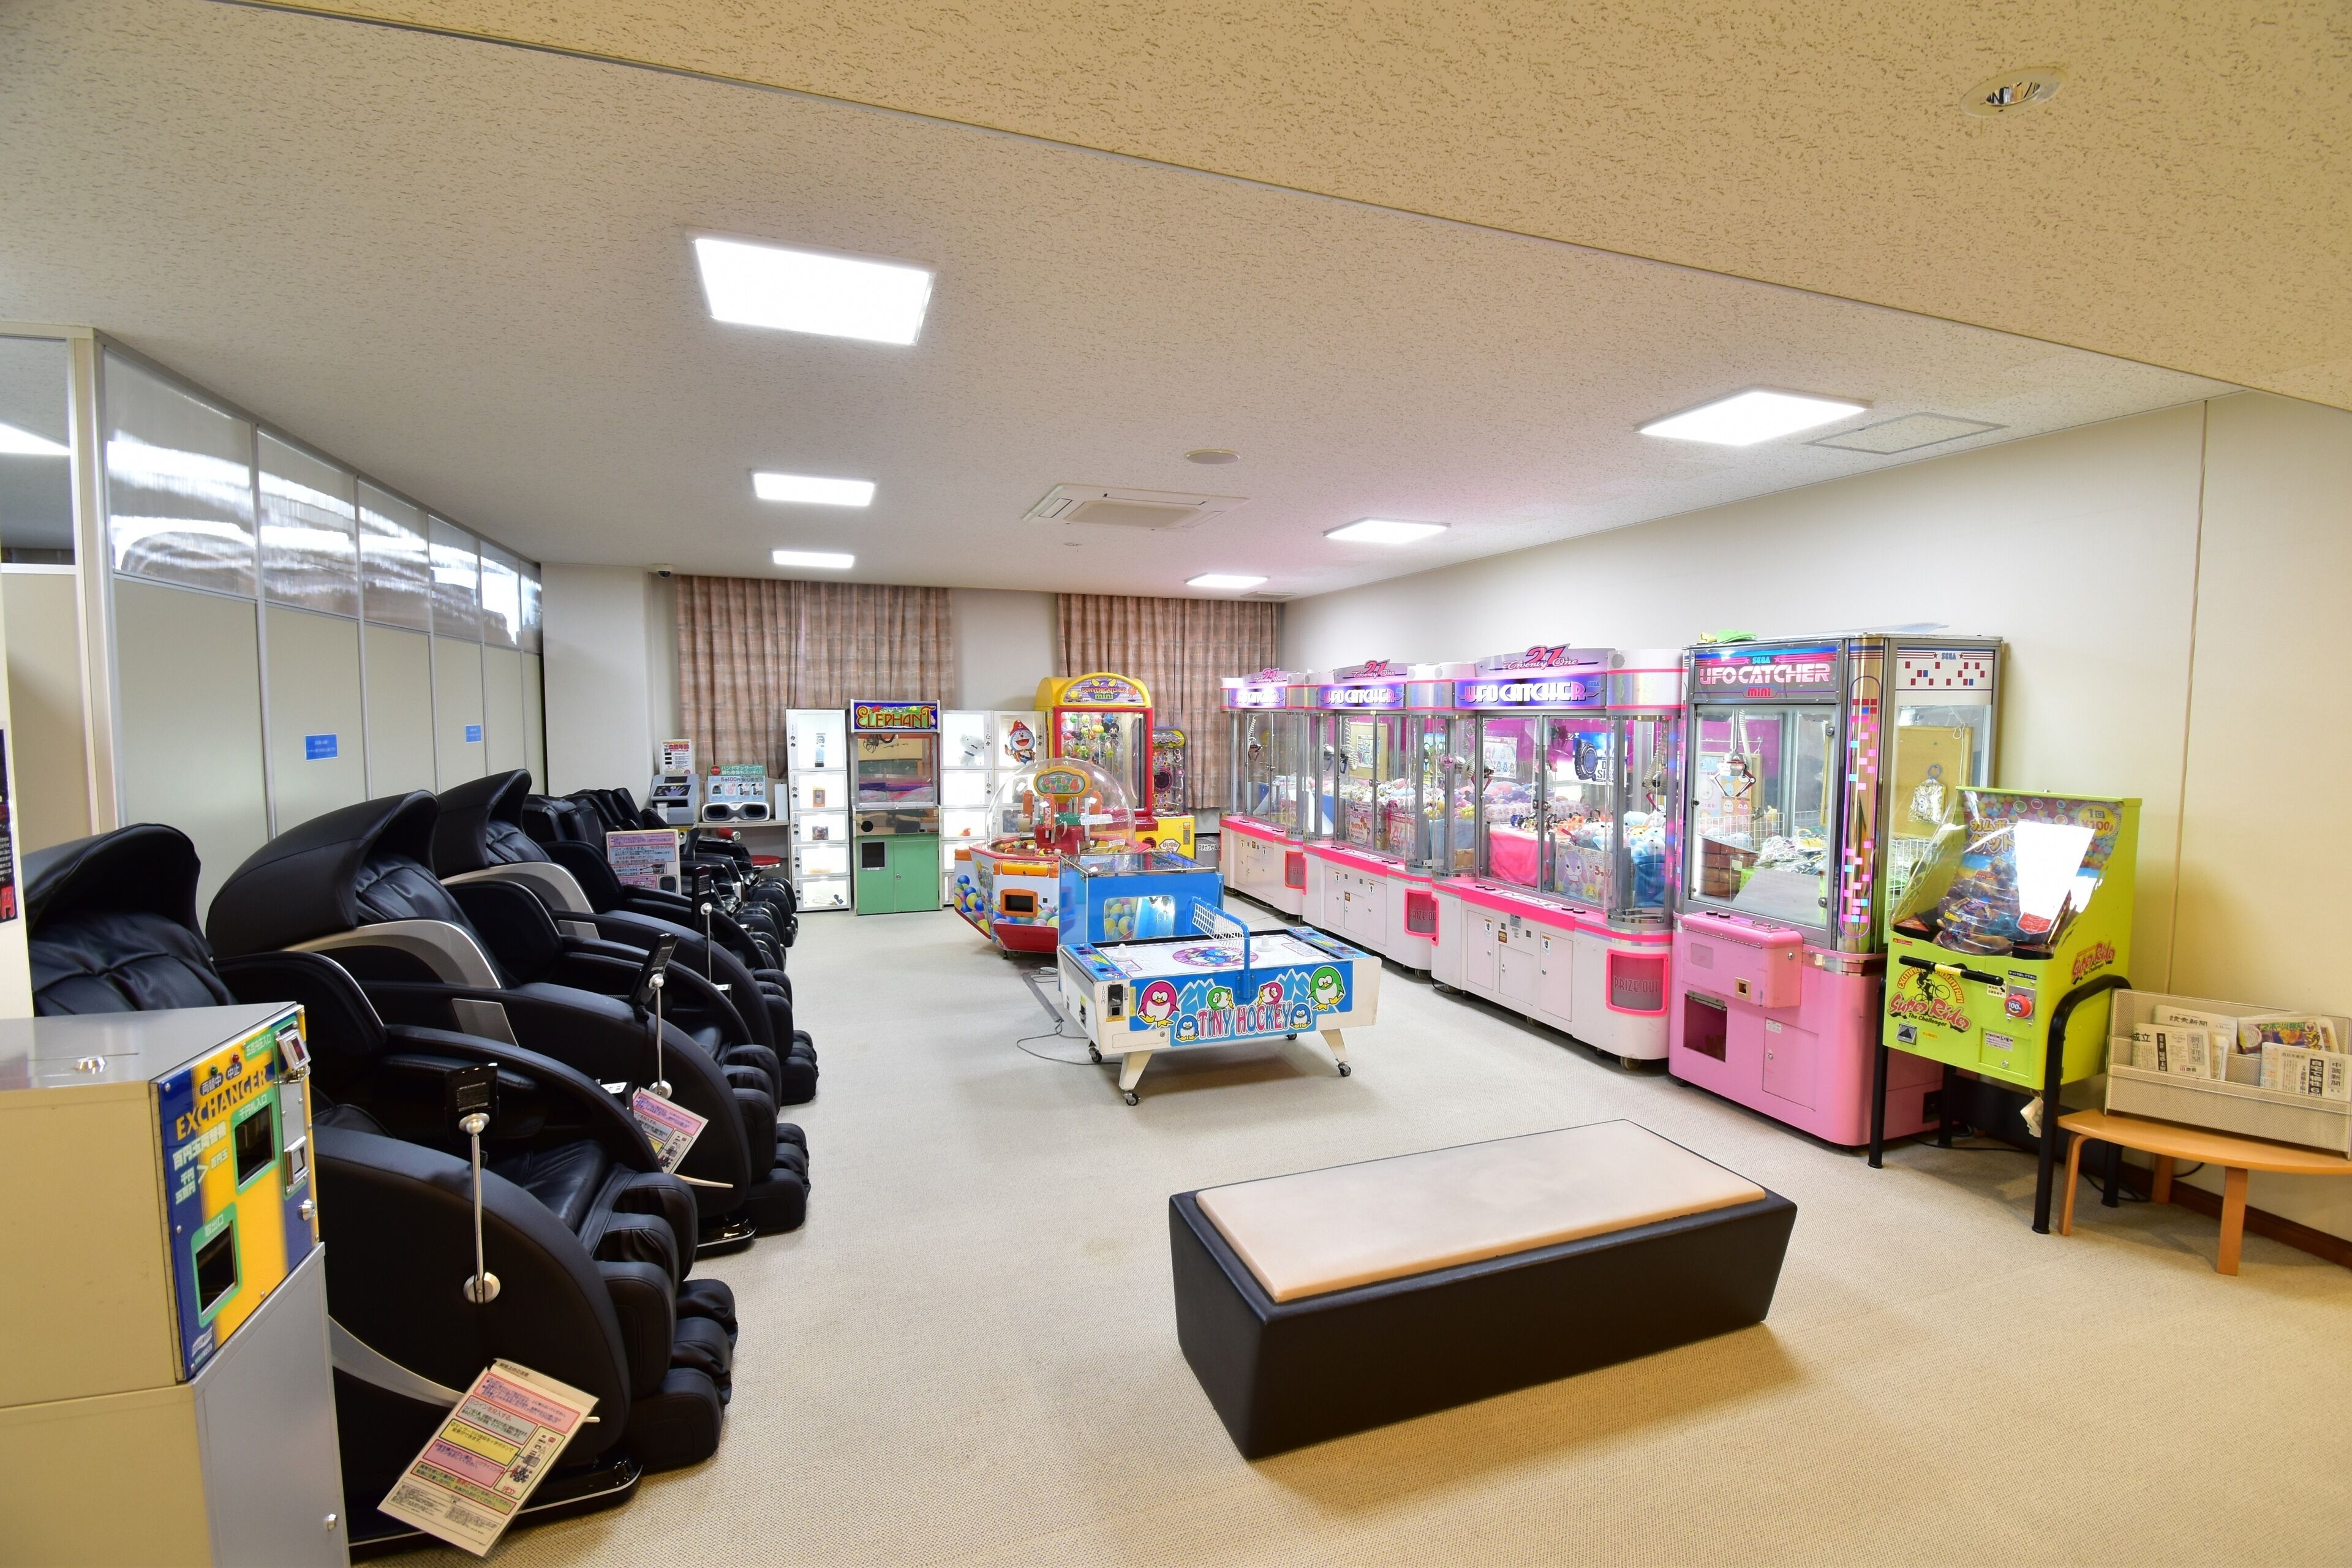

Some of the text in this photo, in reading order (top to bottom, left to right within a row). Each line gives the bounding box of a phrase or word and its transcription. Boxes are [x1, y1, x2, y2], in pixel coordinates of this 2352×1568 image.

[1502, 657, 1578, 669] Twenty One
[1700, 663, 1831, 685] UFO CATCHER
[1464, 684, 1499, 703] UFO
[1747, 687, 1771, 696] mini
[856, 705, 937, 728] ELEPHANT
[2088, 809, 2105, 818] 1回
[1614, 976, 1659, 992] PRIZE OUT
[1198, 1002, 1292, 1038] TINY HOCKEY
[1889, 992, 1971, 1030] Super Rider
[1917, 1015, 1948, 1027] Challenger
[227, 1065, 239, 1078] 中止
[202, 1076, 222, 1095] 両替中
[176, 1066, 266, 1140] EXCHANGER
